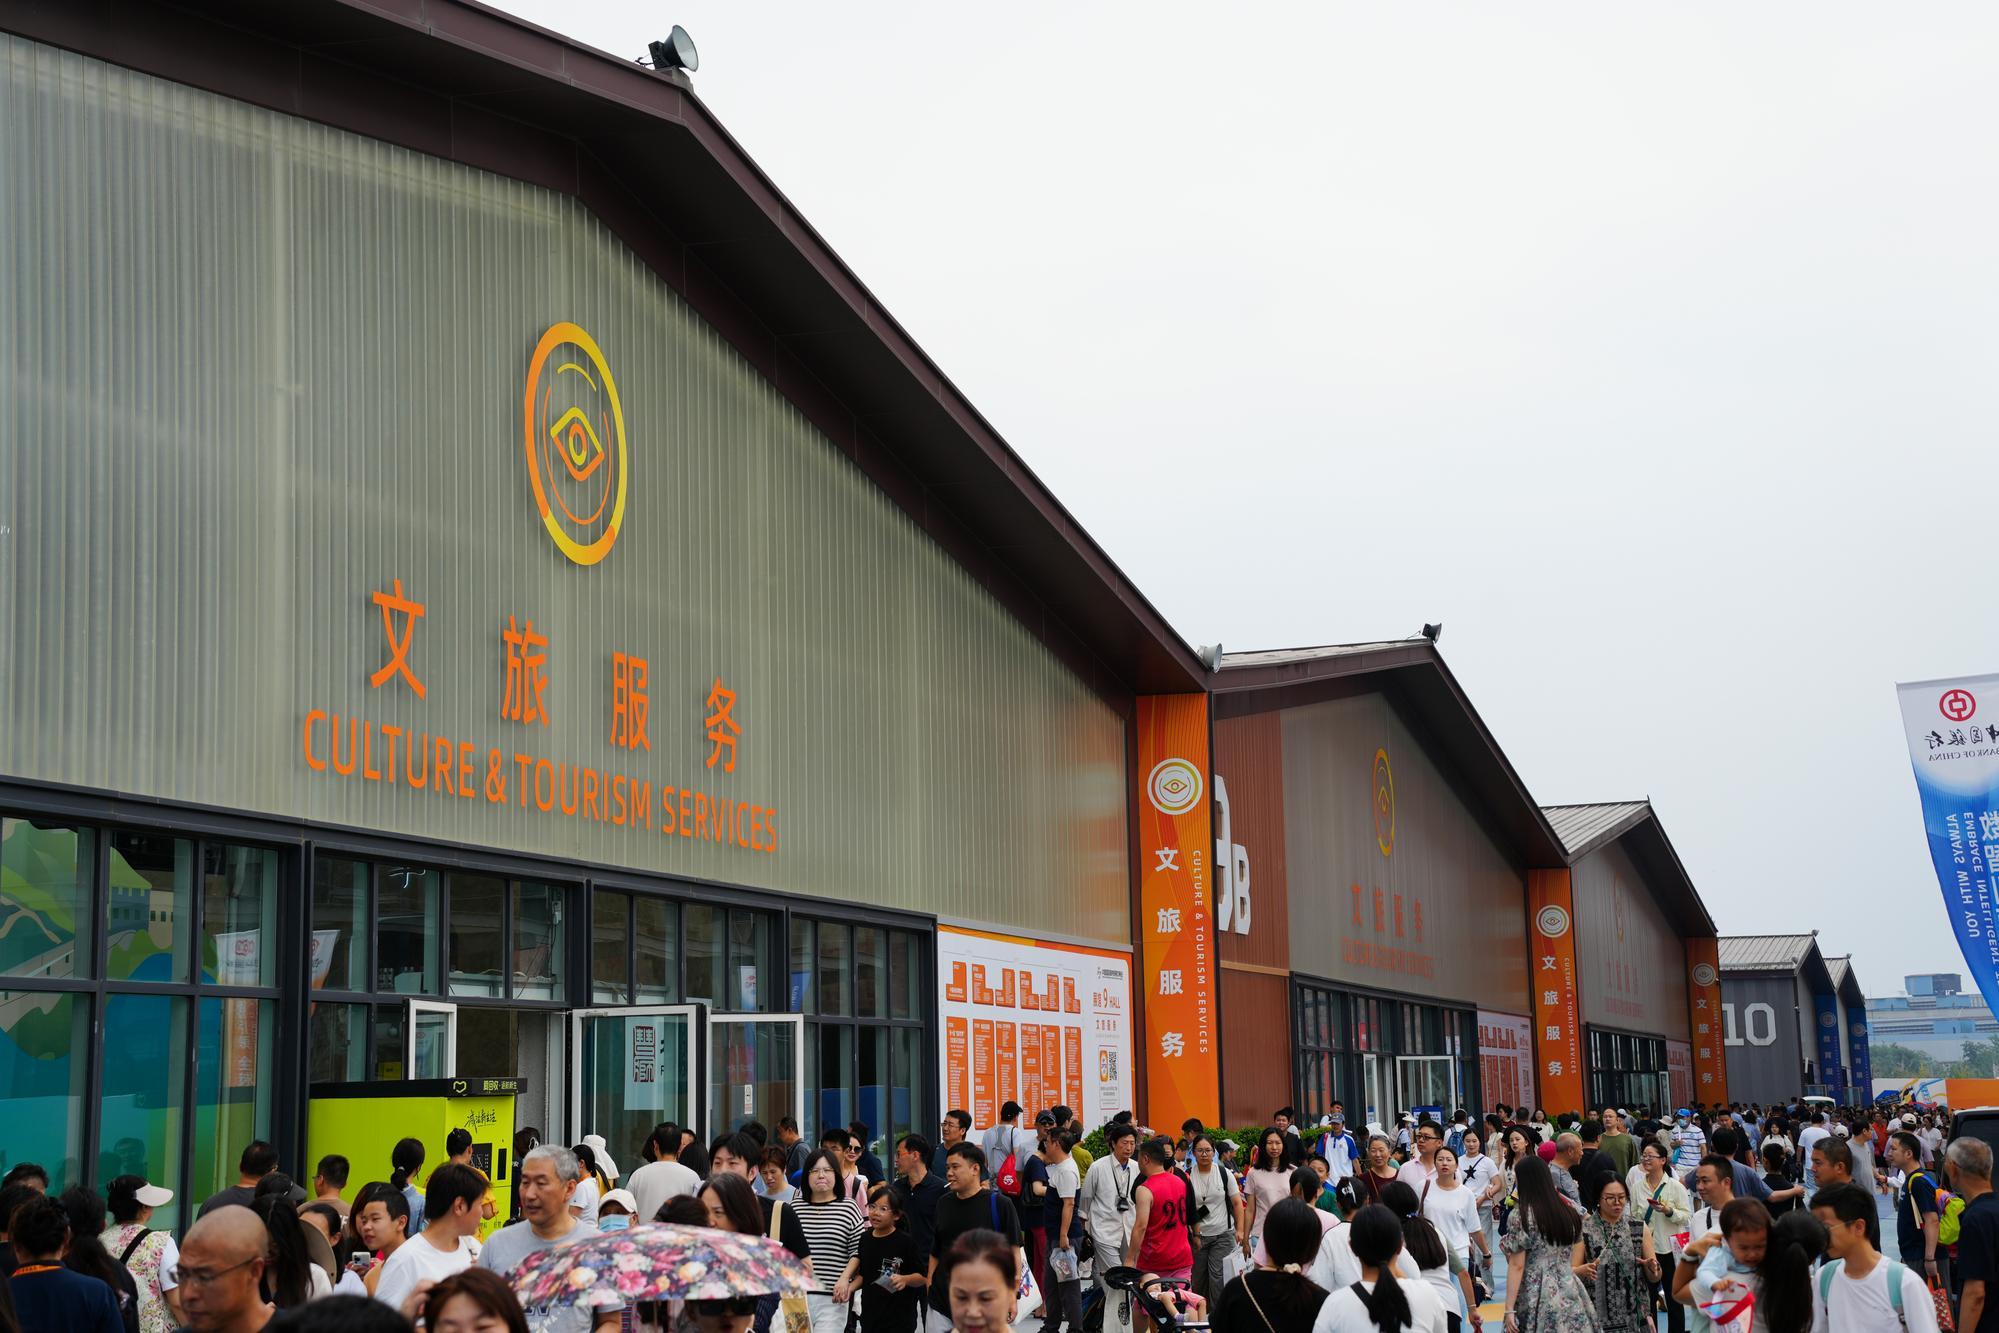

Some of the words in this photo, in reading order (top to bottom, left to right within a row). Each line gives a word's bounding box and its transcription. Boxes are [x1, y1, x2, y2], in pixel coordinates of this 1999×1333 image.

[370, 579, 742, 773] 文旅服务
[304, 710, 476, 798] CULTURE
[485, 748, 507, 803] &
[515, 754, 652, 829] TOURISM
[663, 786, 778, 853] SERVICES
[1192, 850, 1203, 906] CULTURE
[1195, 912, 1204, 920] &
[1155, 846, 1185, 1058] 文旅服务
[1195, 926, 1207, 984] TOURISM
[1197, 991, 1208, 1053] SERVICES
[1542, 955, 1563, 1076] 文旅服务
[1721, 1003, 1777, 1046] 10
